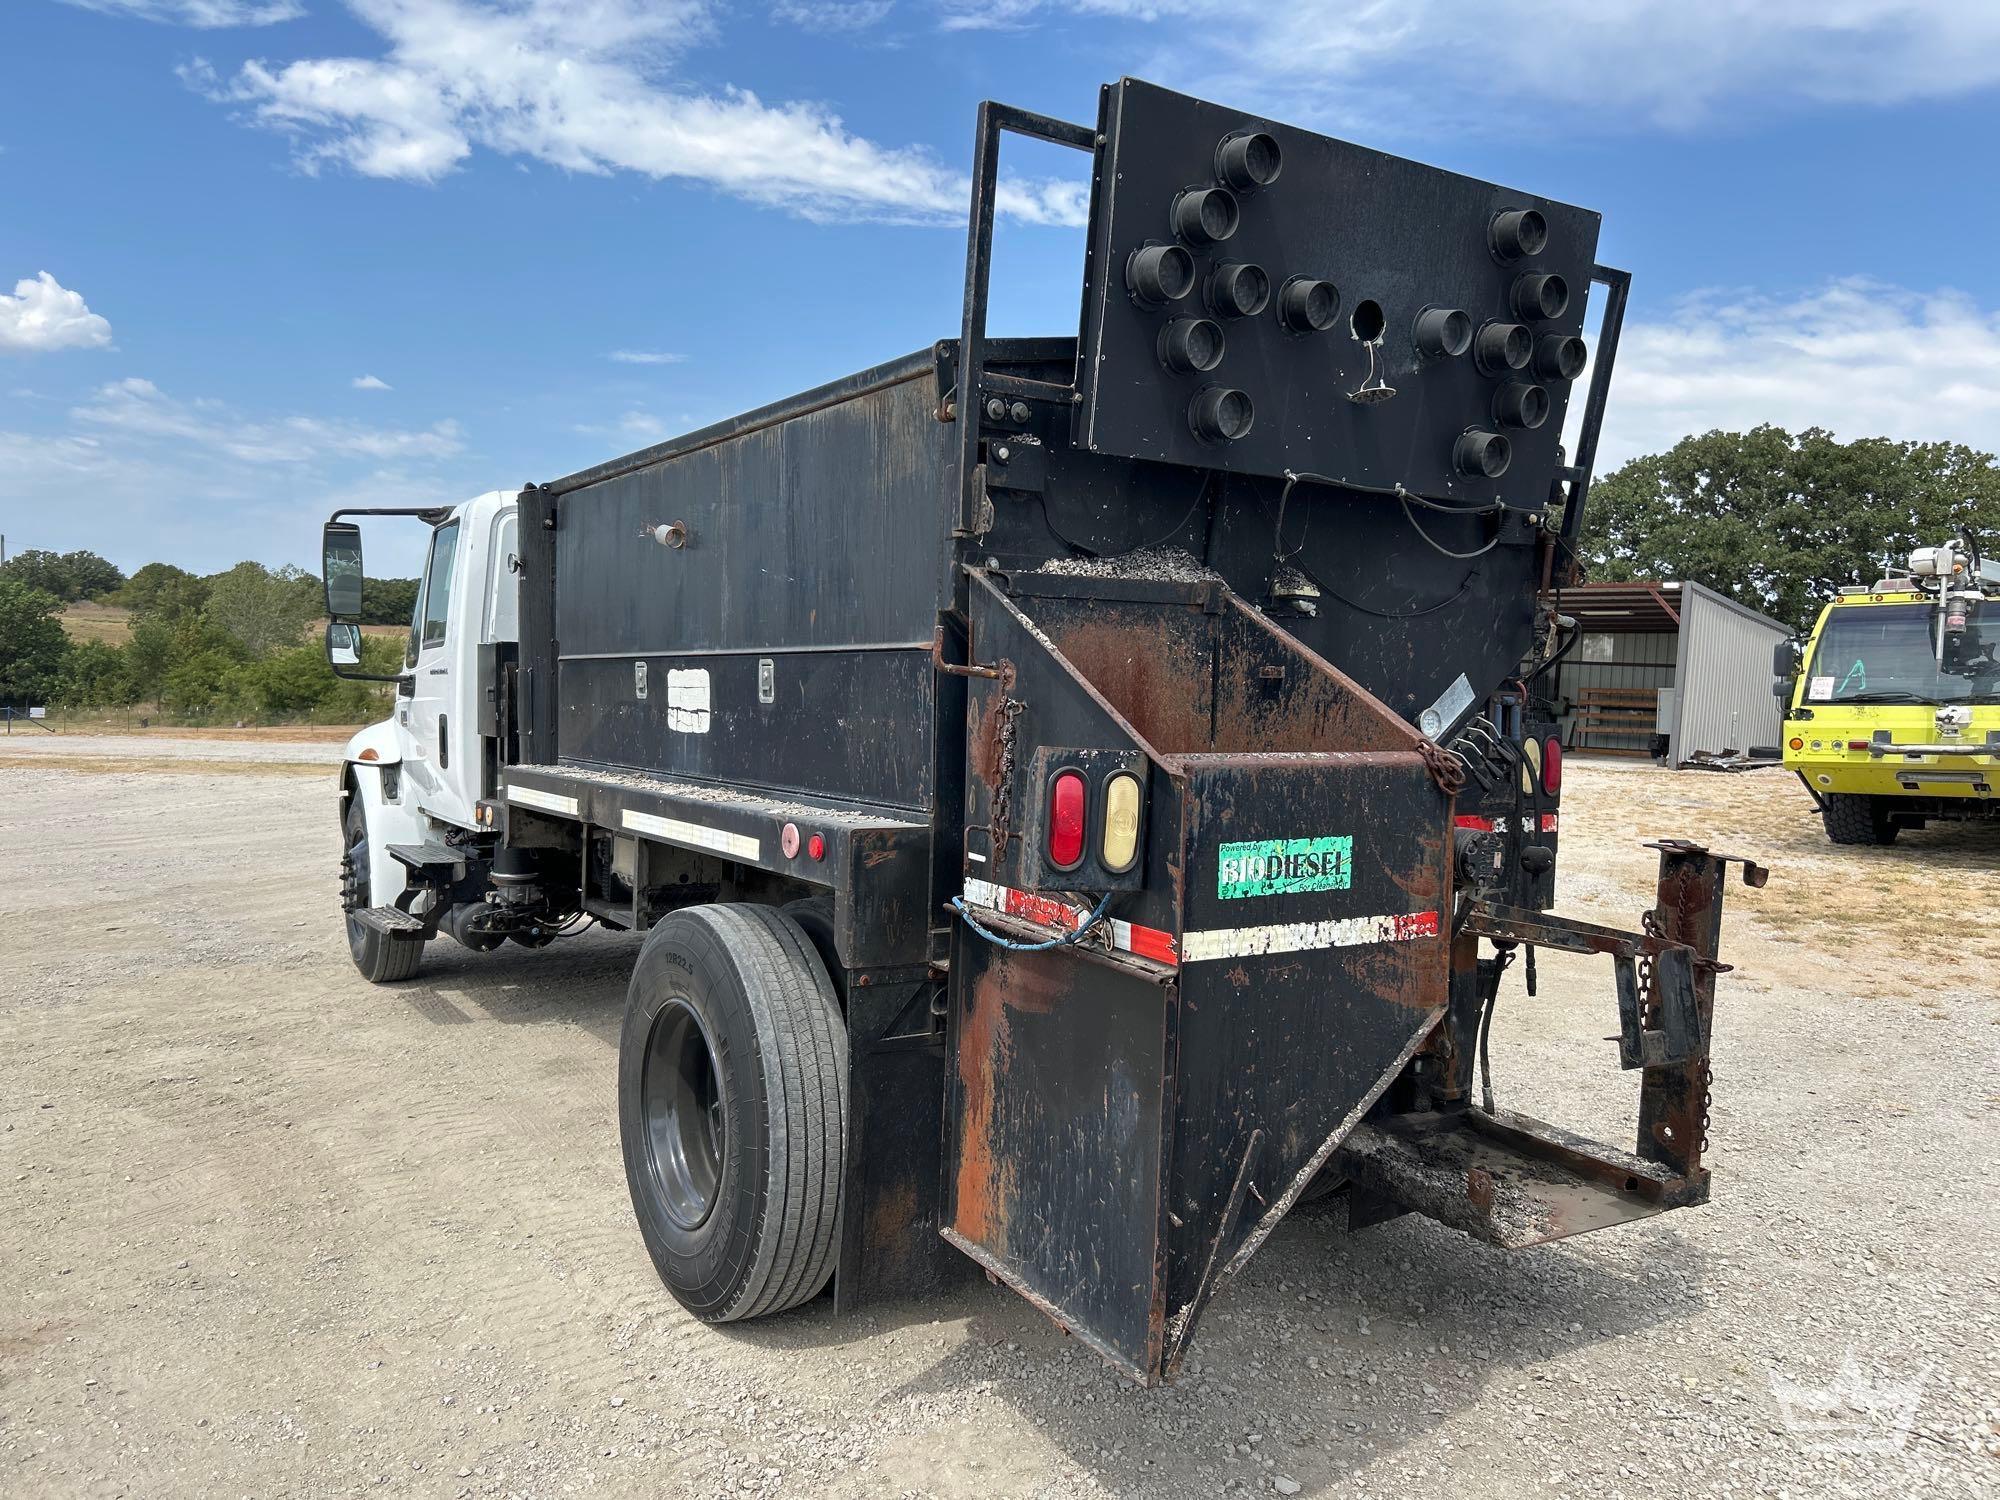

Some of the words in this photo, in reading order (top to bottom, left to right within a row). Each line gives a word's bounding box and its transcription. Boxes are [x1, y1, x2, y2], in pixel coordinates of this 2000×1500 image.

[1836, 659, 1866, 693] A
[1220, 843, 1252, 852] Powered
[1252, 843, 1262, 852] by
[1221, 851, 1348, 884] BIODIESEL
